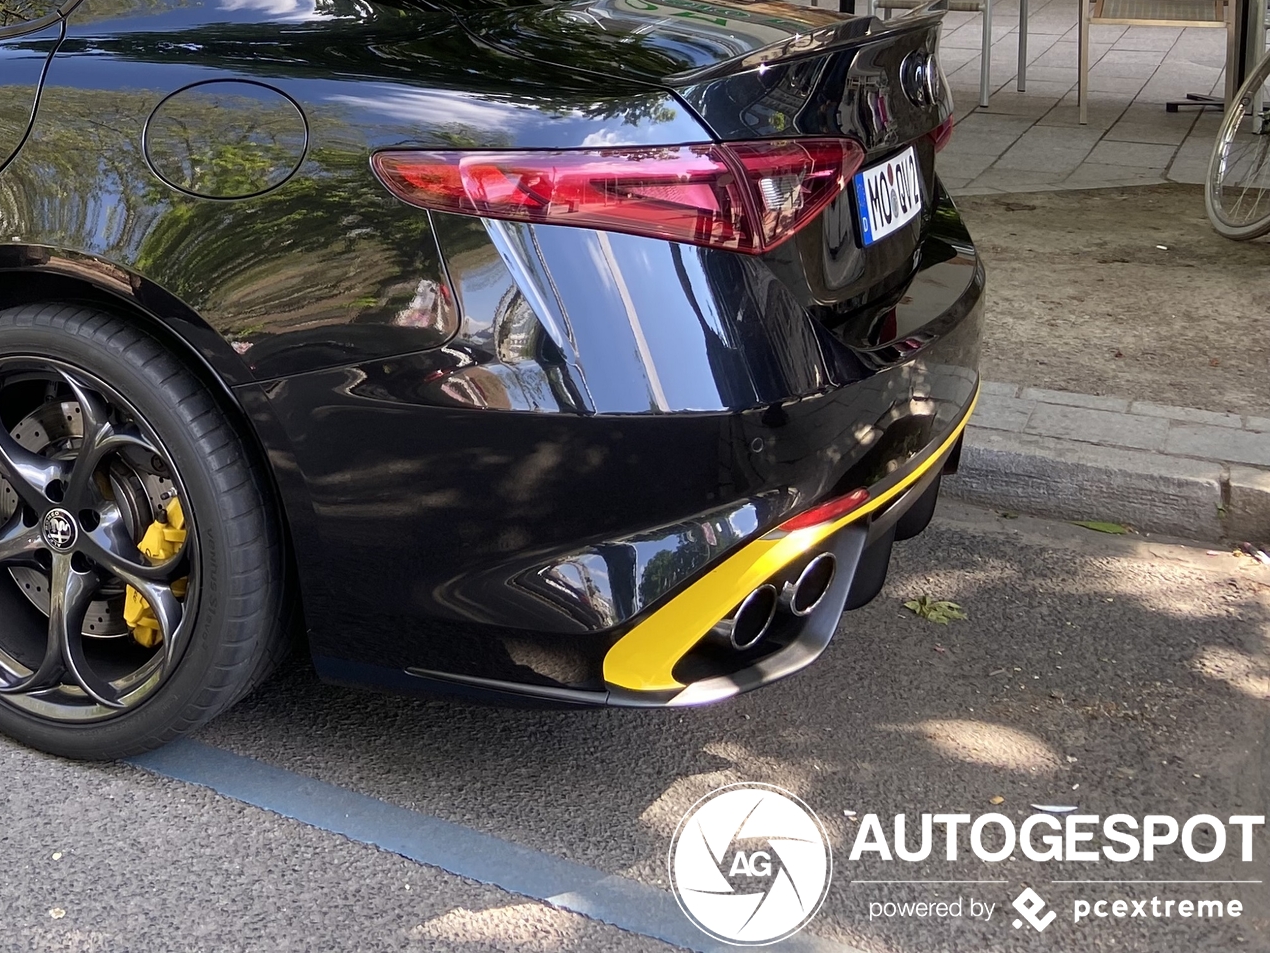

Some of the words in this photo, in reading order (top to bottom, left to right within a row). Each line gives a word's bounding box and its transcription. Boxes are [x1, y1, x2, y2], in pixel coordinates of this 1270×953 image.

[867, 170, 893, 232] MO
[895, 160, 913, 215] QV
[908, 154, 920, 205] 2
